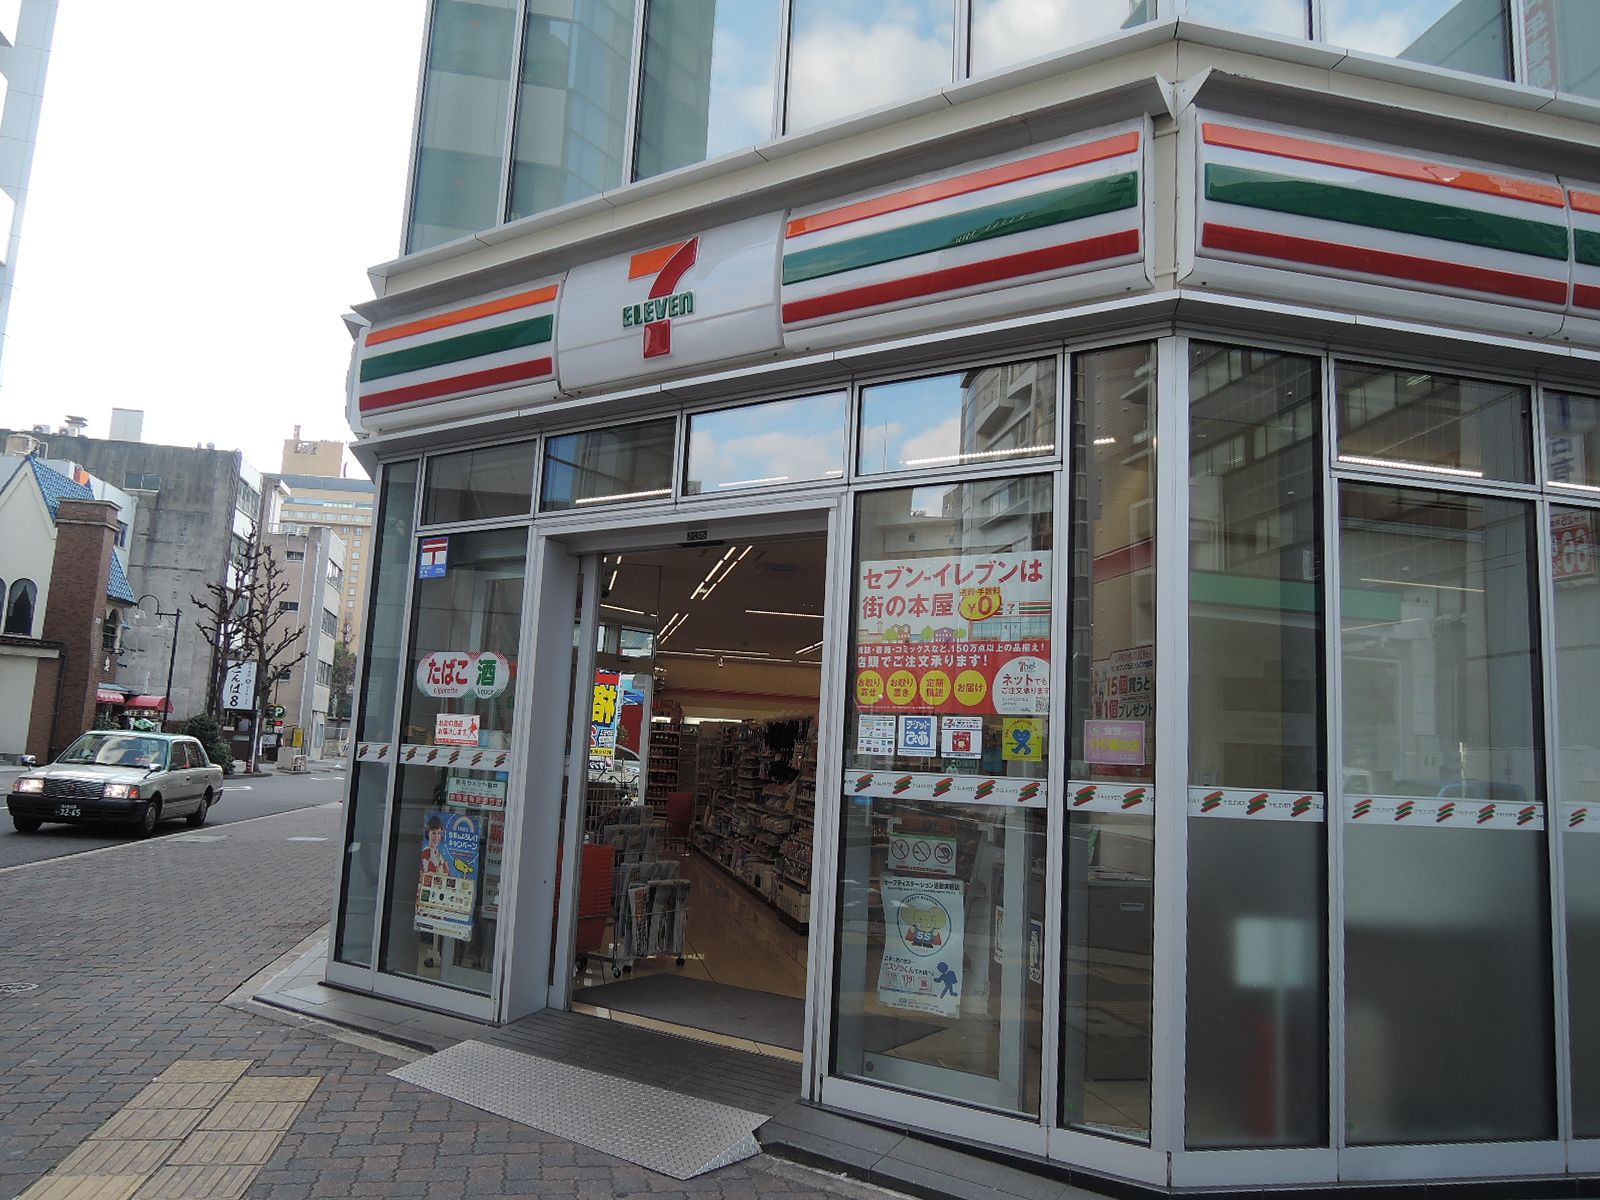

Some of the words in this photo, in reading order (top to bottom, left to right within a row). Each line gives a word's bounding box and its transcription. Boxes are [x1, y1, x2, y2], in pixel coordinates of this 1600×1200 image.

[629, 236, 699, 359] 7
[863, 593, 954, 619] 街の本屋
[427, 659, 469, 685] たばこ
[476, 659, 497, 686] 酒
[858, 678, 880, 687] お取り
[890, 678, 913, 687] お取り
[1003, 674, 1047, 686] ネットでも
[957, 683, 983, 693] お届け
[906, 720, 930, 730] チケット
[906, 731, 929, 746] ぴあ
[916, 931, 931, 941] SS
